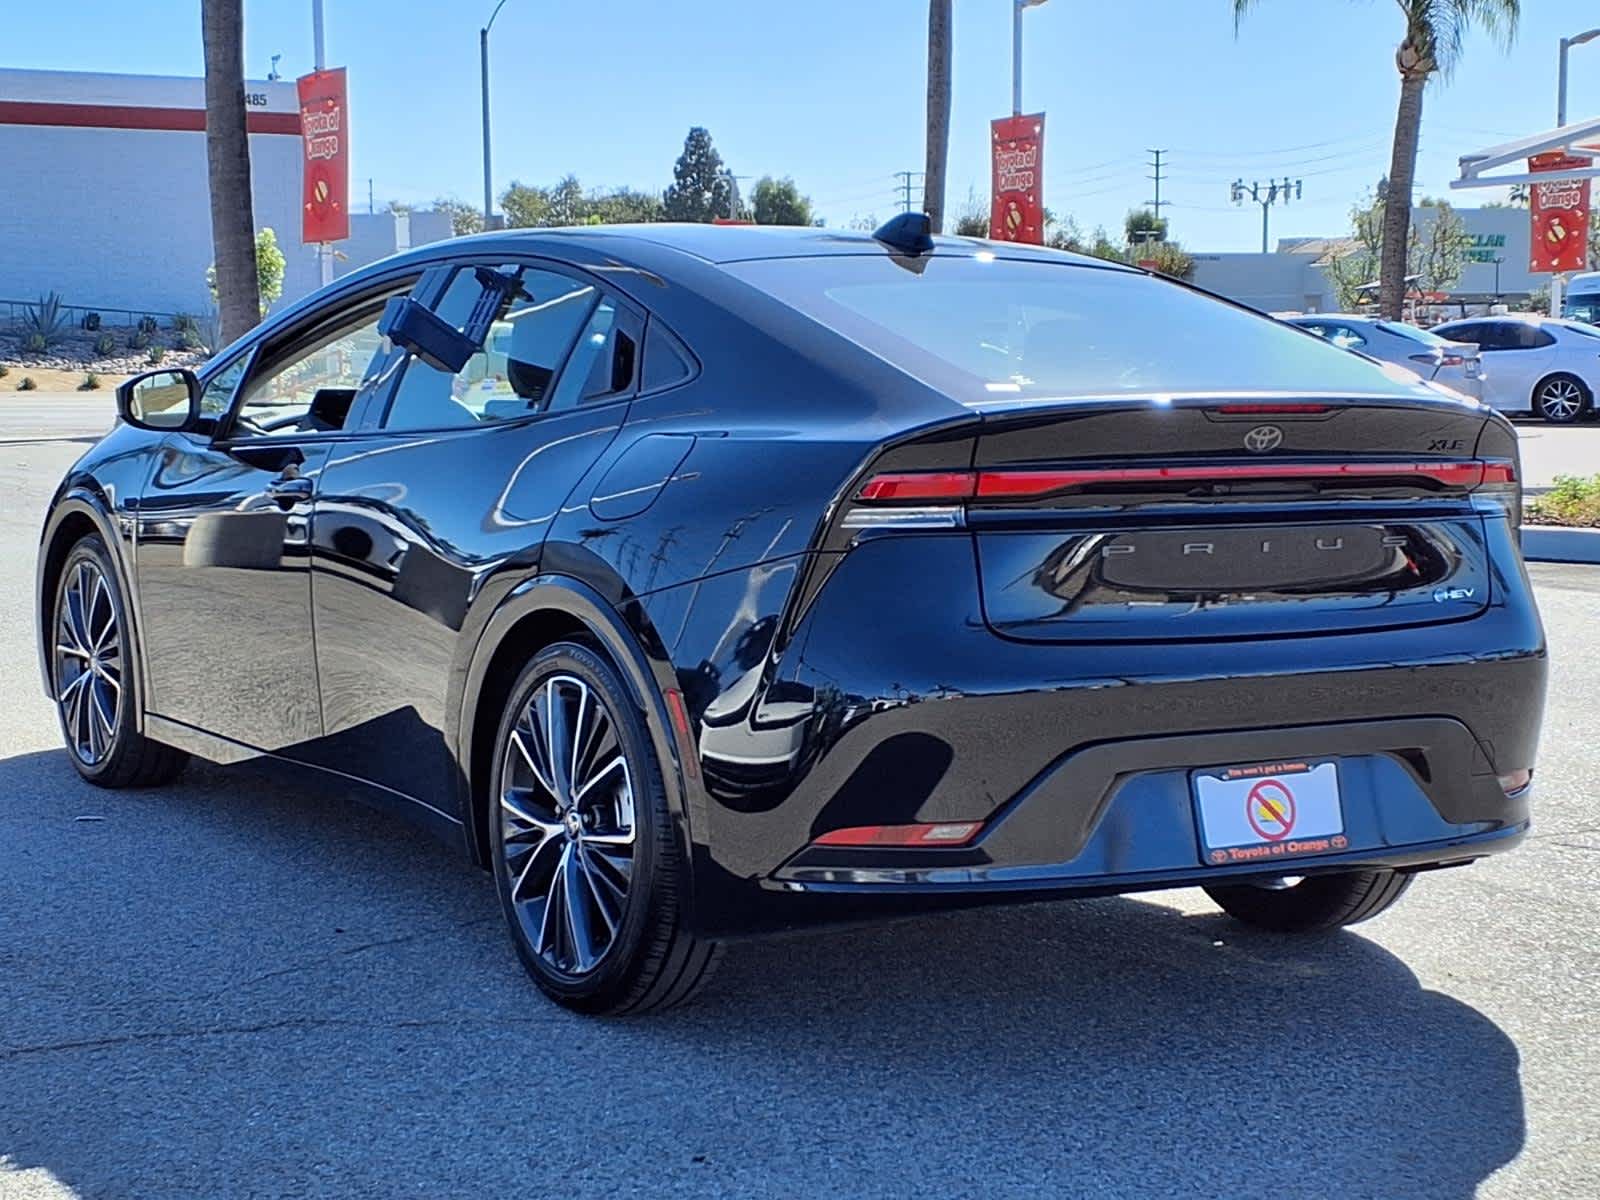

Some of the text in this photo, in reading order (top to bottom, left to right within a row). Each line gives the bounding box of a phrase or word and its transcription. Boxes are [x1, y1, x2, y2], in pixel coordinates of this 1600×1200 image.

[996, 145, 1037, 174] Toyota of
[999, 171, 1034, 192] Orange
[1539, 190, 1581, 209] Orange
[1427, 439, 1465, 451] XLE
[1102, 536, 1408, 557] PRIUS
[1228, 838, 1329, 860] Toyota of Orange
